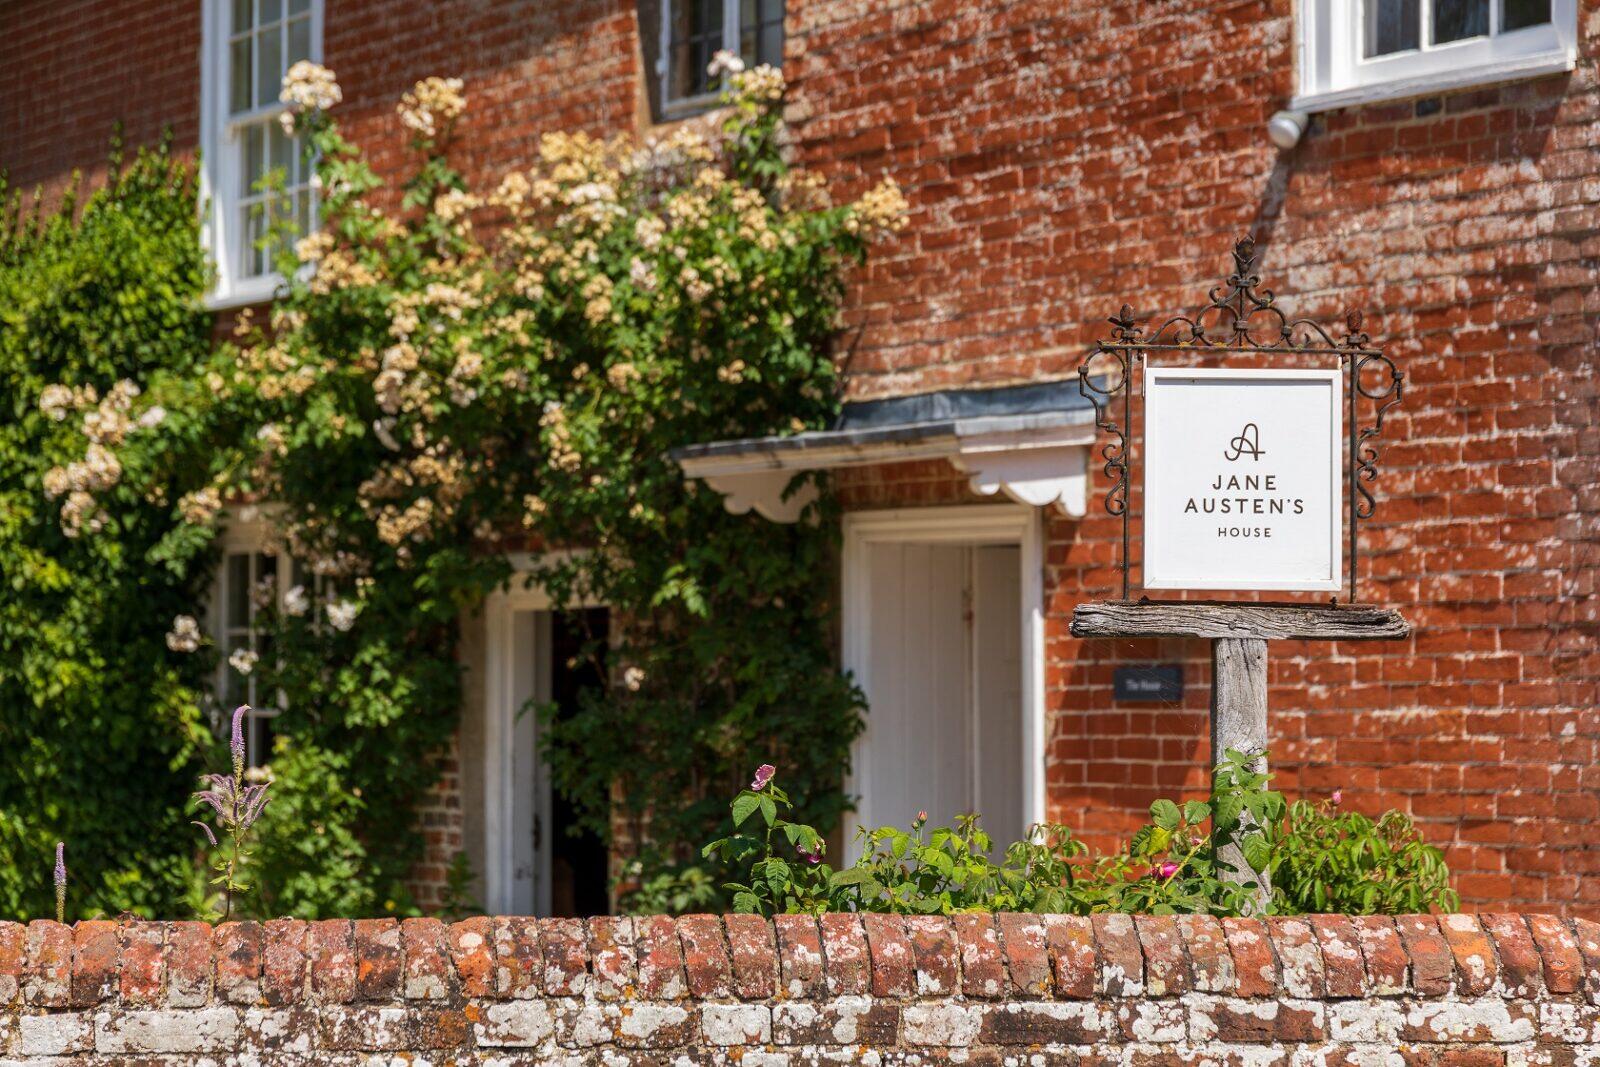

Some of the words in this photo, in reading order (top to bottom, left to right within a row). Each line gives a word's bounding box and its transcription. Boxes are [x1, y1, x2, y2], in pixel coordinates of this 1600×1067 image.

[1212, 475, 1277, 490] JANE
[1184, 498, 1304, 514] AUSTEN'S
[1218, 528, 1272, 538] HOUSE
